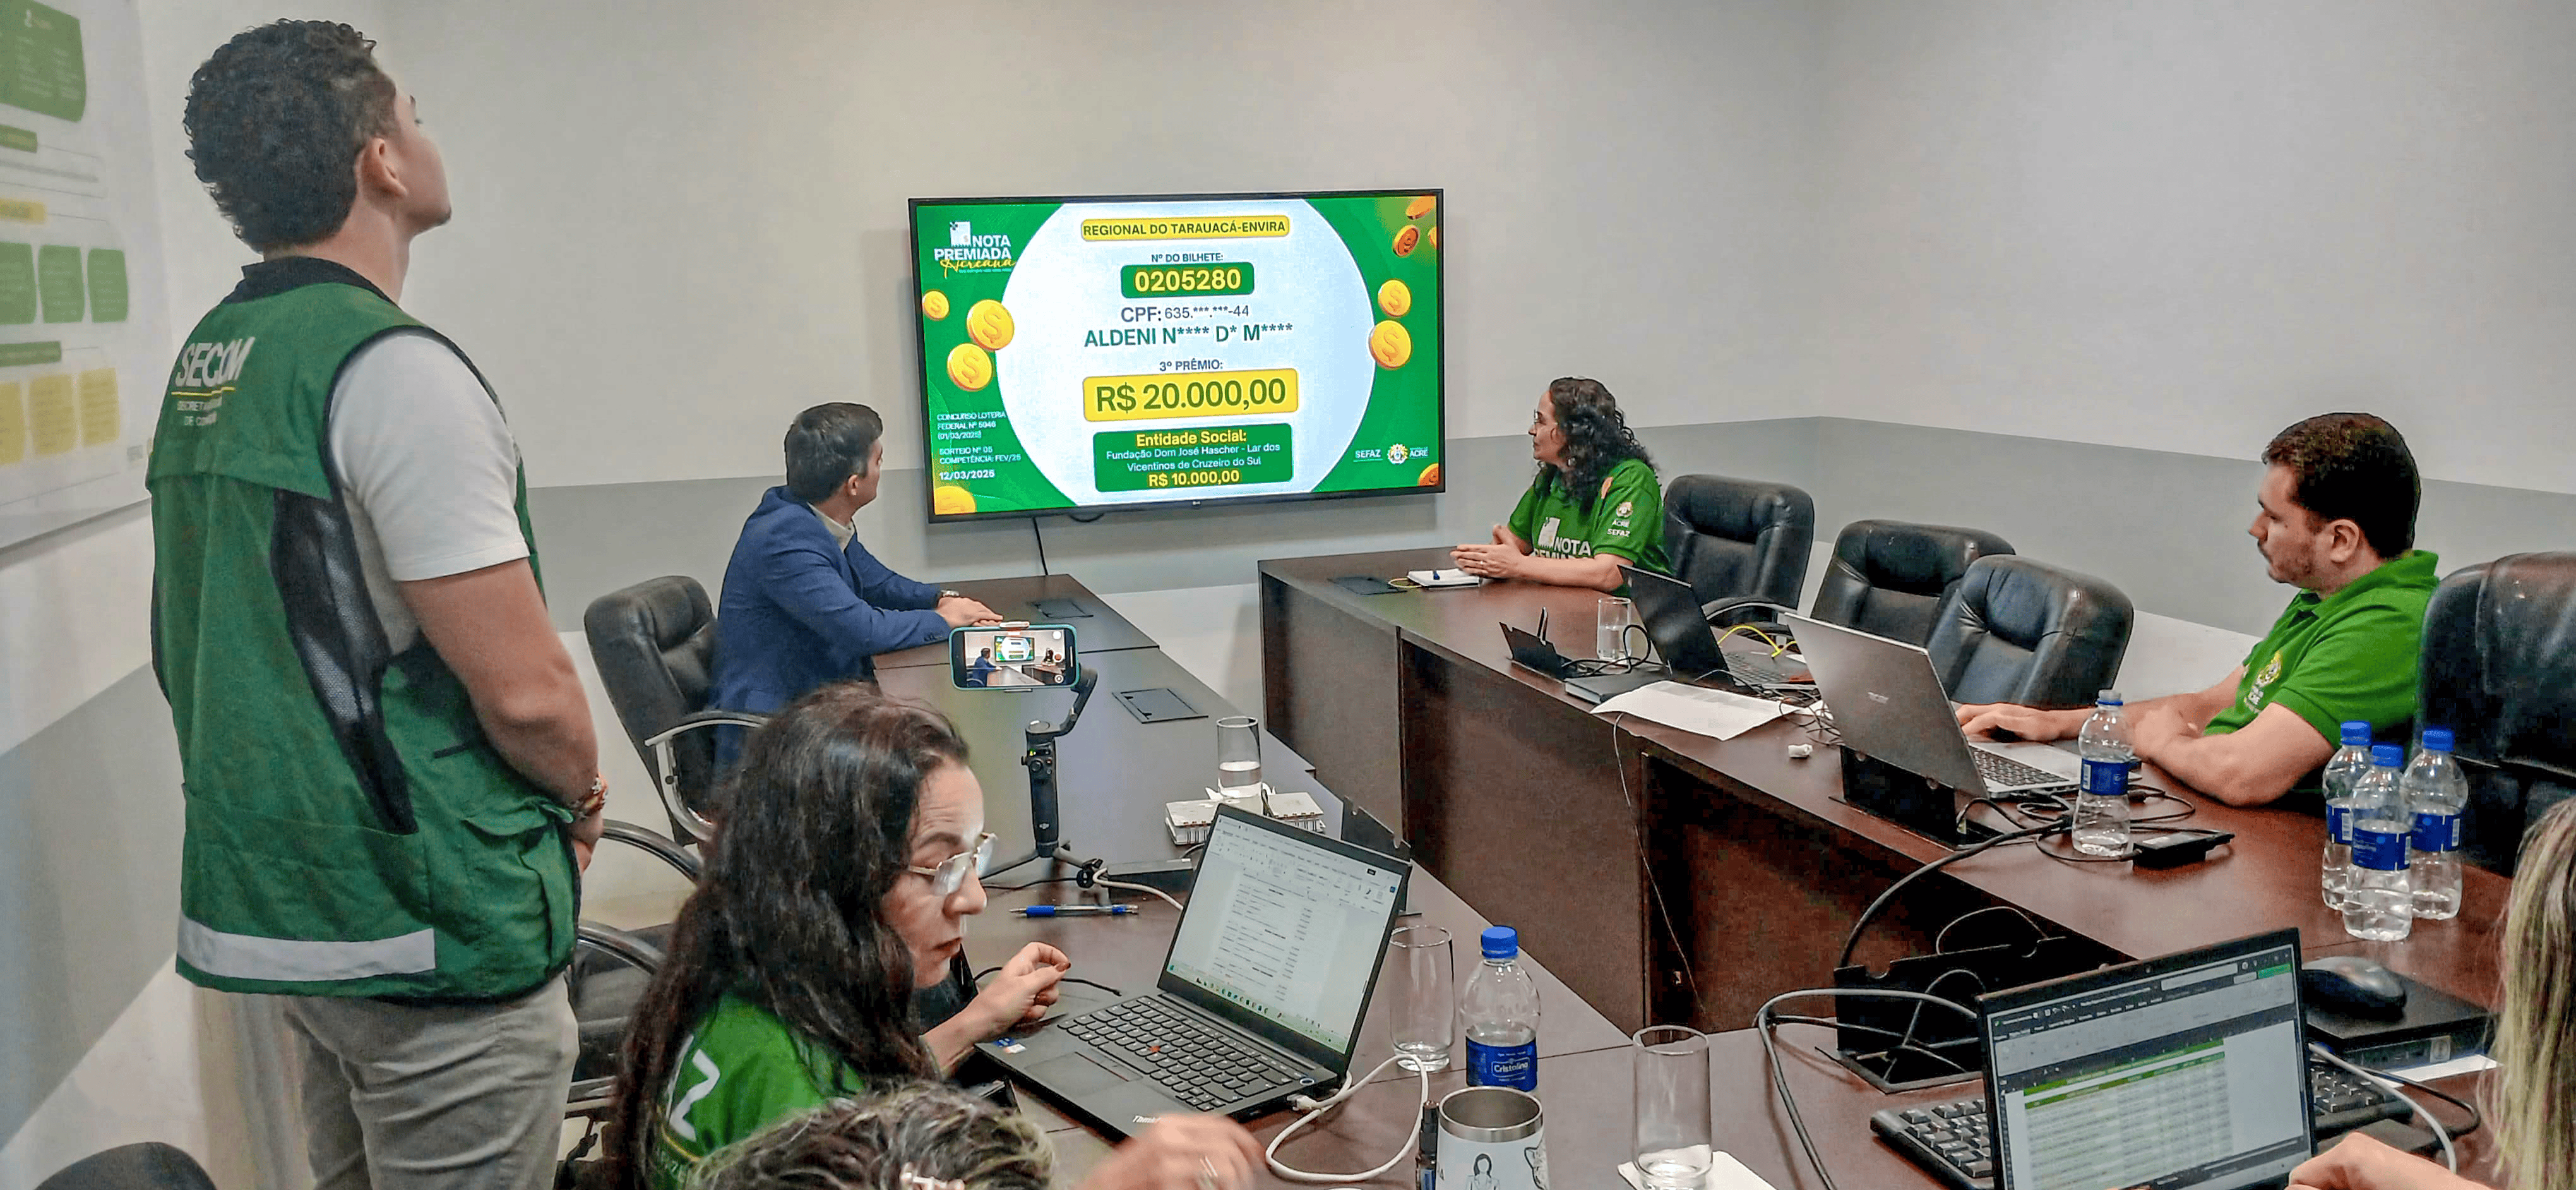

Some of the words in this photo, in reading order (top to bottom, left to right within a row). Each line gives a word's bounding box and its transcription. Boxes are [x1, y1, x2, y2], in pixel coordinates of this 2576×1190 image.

[1083, 224, 1147, 236] REGIONAL
[1150, 224, 1167, 234] DO
[1171, 220, 1285, 234] TARAUACÁ-ENVIRA
[972, 234, 1011, 247] NOTA
[934, 247, 1011, 261] PREMIADA
[1152, 254, 1163, 262] Nº
[1166, 254, 1180, 262] DO
[1182, 253, 1223, 261] BILHETE:
[1135, 268, 1241, 292] 0205280
[1121, 306, 1162, 323] CPF:
[1084, 327, 1156, 347] ALDENI
[175, 336, 256, 387] SECOM
[1159, 361, 1172, 371] 3º
[1176, 359, 1224, 371] PRÊMIO:
[1096, 382, 1136, 414] R$
[1143, 378, 1286, 411] 20.000,00
[1136, 432, 1197, 447] Entidade
[1200, 430, 1247, 443] Social:
[1106, 450, 1152, 460] Fundação
[1154, 449, 1176, 457] Dom
[1178, 447, 1199, 457] José
[1263, 443, 1280, 452] dos
[1355, 449, 1381, 458] SEFAZ
[1126, 462, 1175, 472] Vicentinos
[1178, 460, 1190, 469] de
[1191, 458, 1231, 468] Cruzeiro
[1232, 457, 1245, 466] do
[1246, 456, 1261, 465] Sul
[1148, 473, 1168, 487] R$
[1172, 470, 1239, 485] 10.000,00
[1612, 518, 1630, 527] ACRE
[1607, 528, 1630, 537] SEFAZ
[1554, 536, 1591, 556] NOTA
